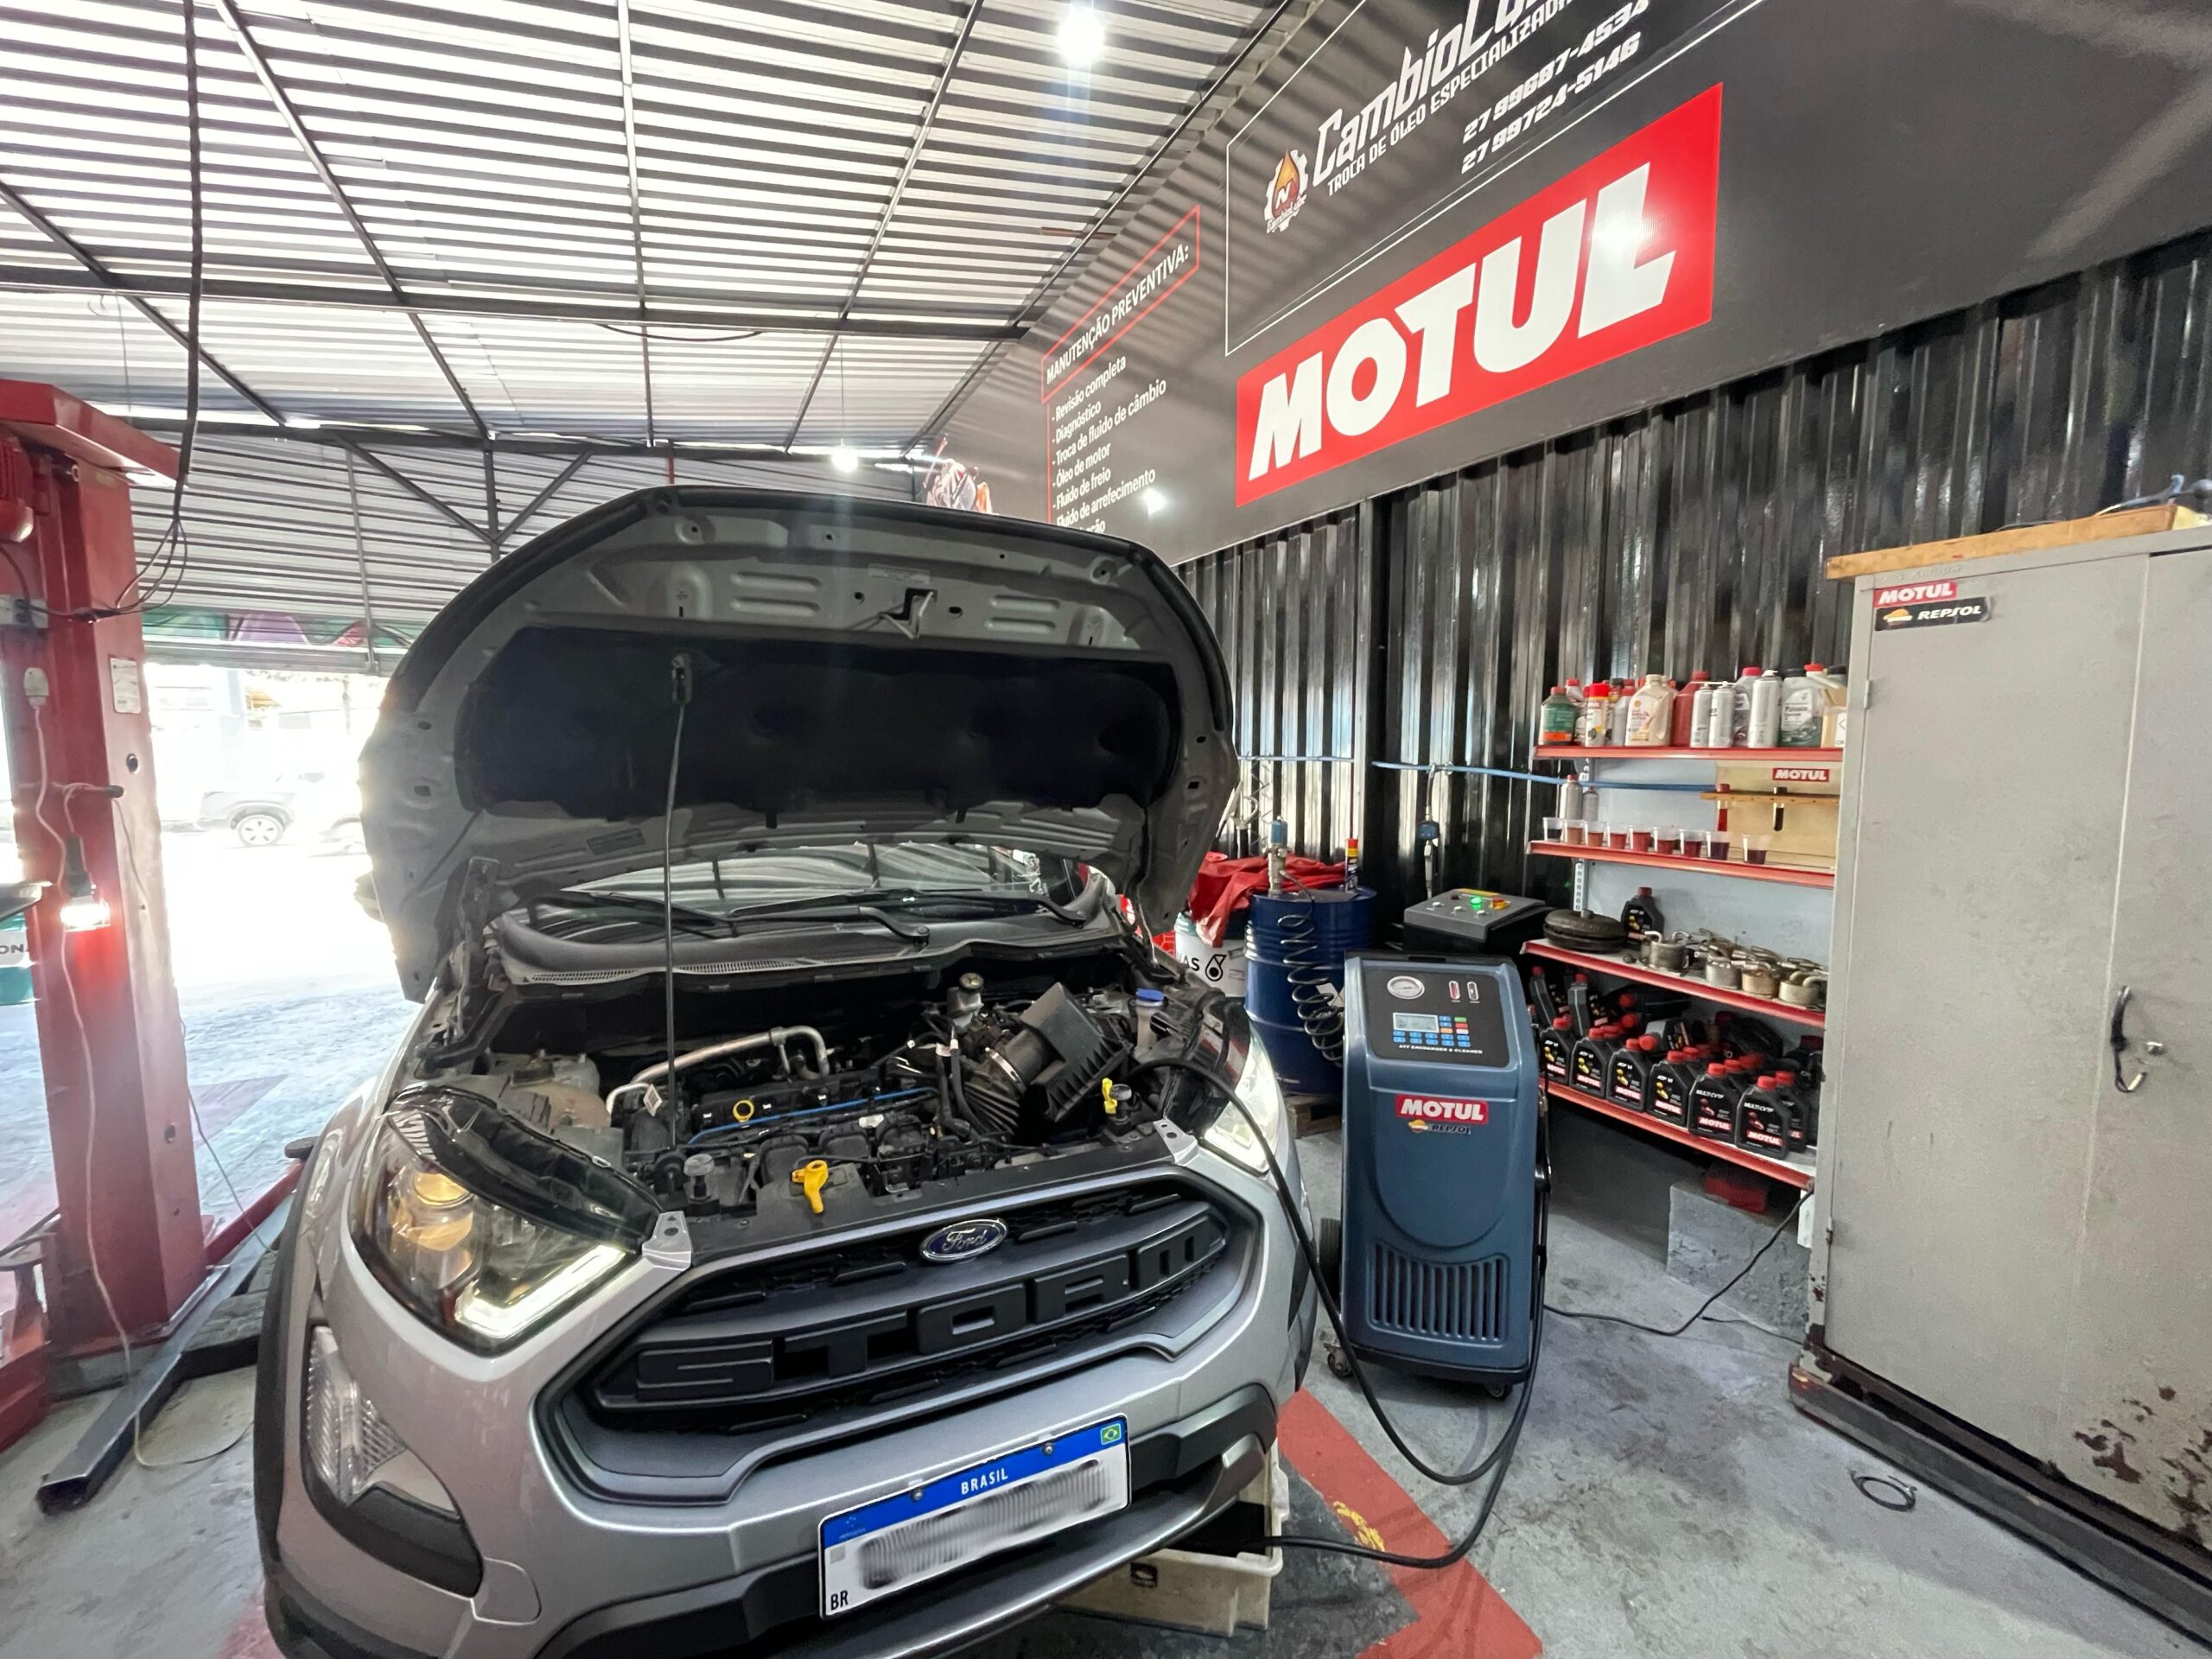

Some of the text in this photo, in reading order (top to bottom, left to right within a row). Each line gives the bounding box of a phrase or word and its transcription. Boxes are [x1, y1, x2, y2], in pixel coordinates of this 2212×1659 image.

[1313, 0, 1541, 188] CambioLu
[1461, 31, 1642, 174] 27 99724-5146
[1462, 108, 1492, 143] 27
[1327, 152, 1366, 196] TROCA
[1369, 135, 1387, 163] DE
[1389, 103, 1426, 147] ÓLEO
[1046, 244, 1189, 385] MANUTENÇÃO PREVENTIVA:
[1248, 162, 1677, 482] MOTUL
[1055, 355, 1127, 423] Revisão completa
[1056, 378, 1166, 466] Troca de fluido de câmbio
[1056, 401, 1102, 445] Diagnóstico
[1056, 442, 1112, 488] Óleo de motor
[1056, 467, 1112, 510] Fluido de freio
[1056, 508, 1079, 527] Fluido
[1079, 502, 1090, 519] de
[1090, 468, 1156, 514] arrefecimento
[1878, 582, 1954, 605] MOTUL
[1917, 605, 1982, 620] REPSOL
[1775, 769, 1827, 781] MOTUL
[1400, 1098, 1484, 1121] MOTUL
[1699, 1117, 1732, 1130] MOTUL
[1747, 1131, 1782, 1146] MOTUL
[941, 1227, 988, 1251] Ford
[636, 1215, 1212, 1395] STORM
[960, 1467, 1009, 1495] BRASIL
[830, 1590, 849, 1611] BR
